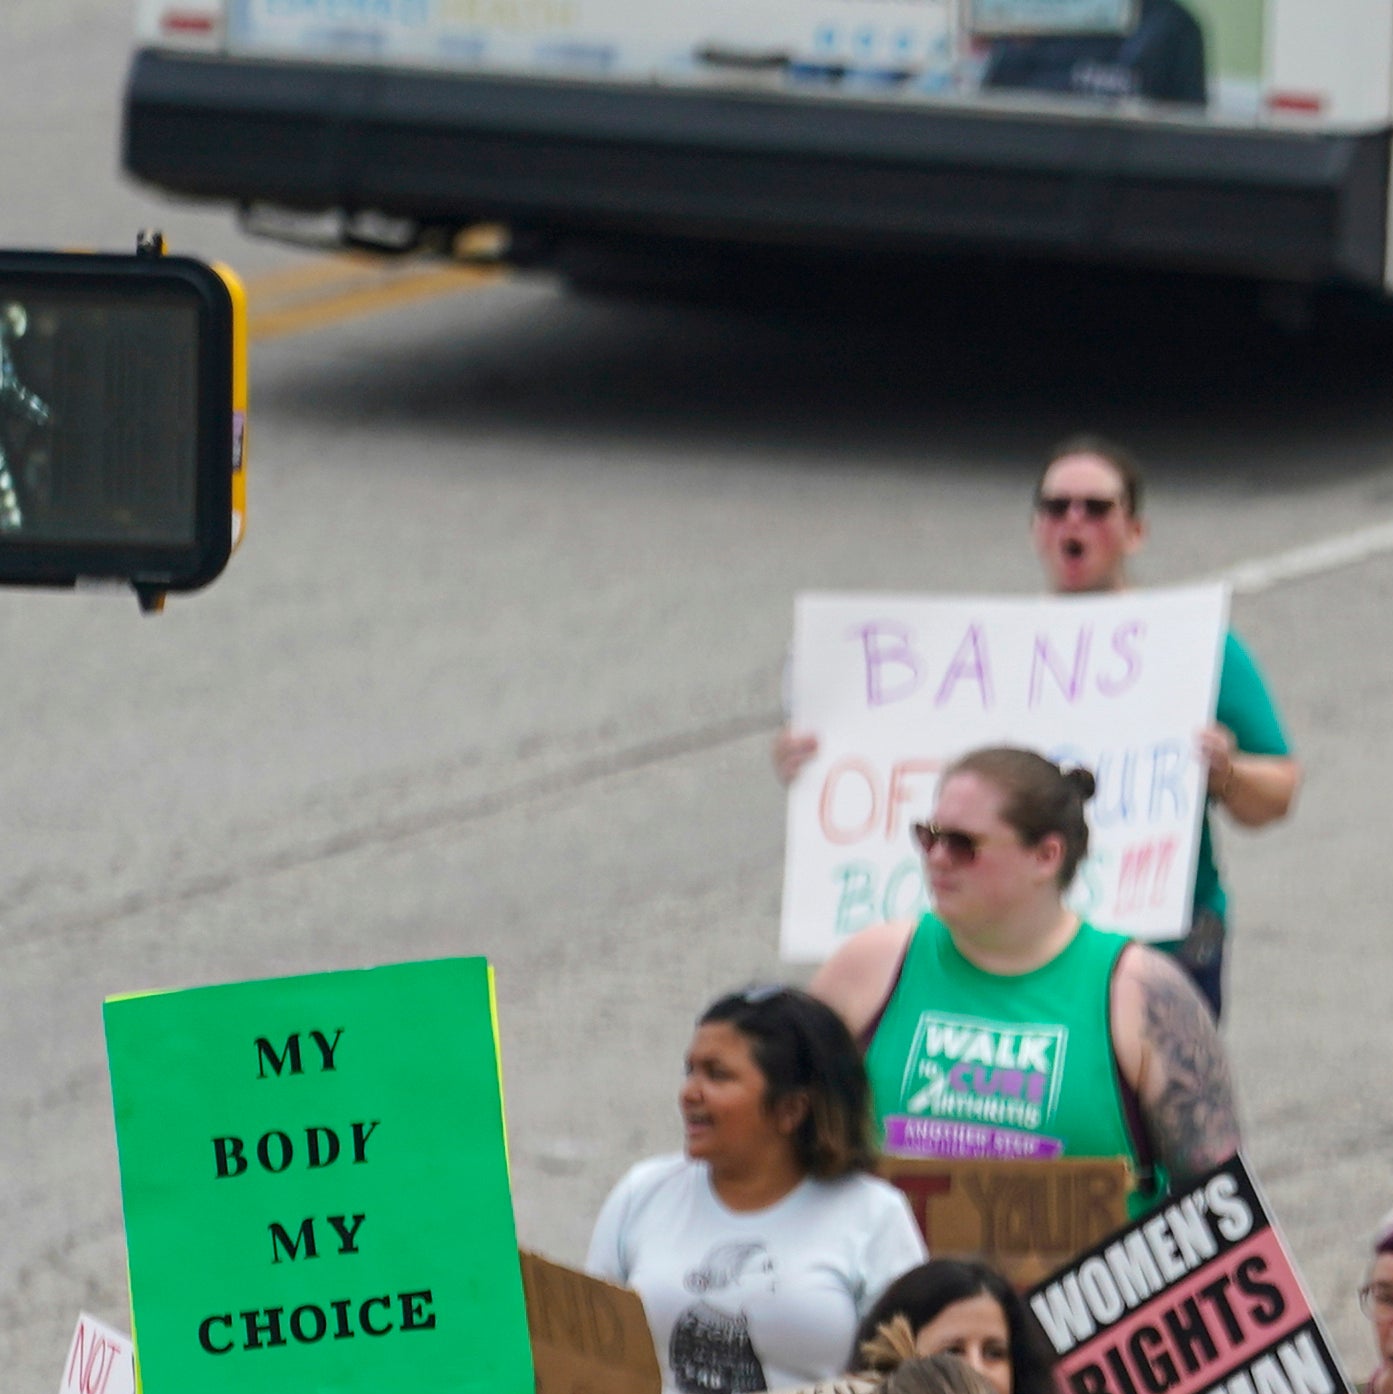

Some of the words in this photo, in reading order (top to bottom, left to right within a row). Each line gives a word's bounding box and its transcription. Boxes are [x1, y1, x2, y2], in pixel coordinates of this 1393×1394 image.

[847, 619, 1146, 711] BANS
[817, 756, 942, 845] OF
[254, 1028, 345, 1080] MY
[925, 1024, 1056, 1073] WALK
[211, 1120, 381, 1181] BODY
[267, 1213, 366, 1266] MY
[1030, 1172, 1253, 1356] WOMEN'S
[197, 1288, 439, 1357] CHOICE
